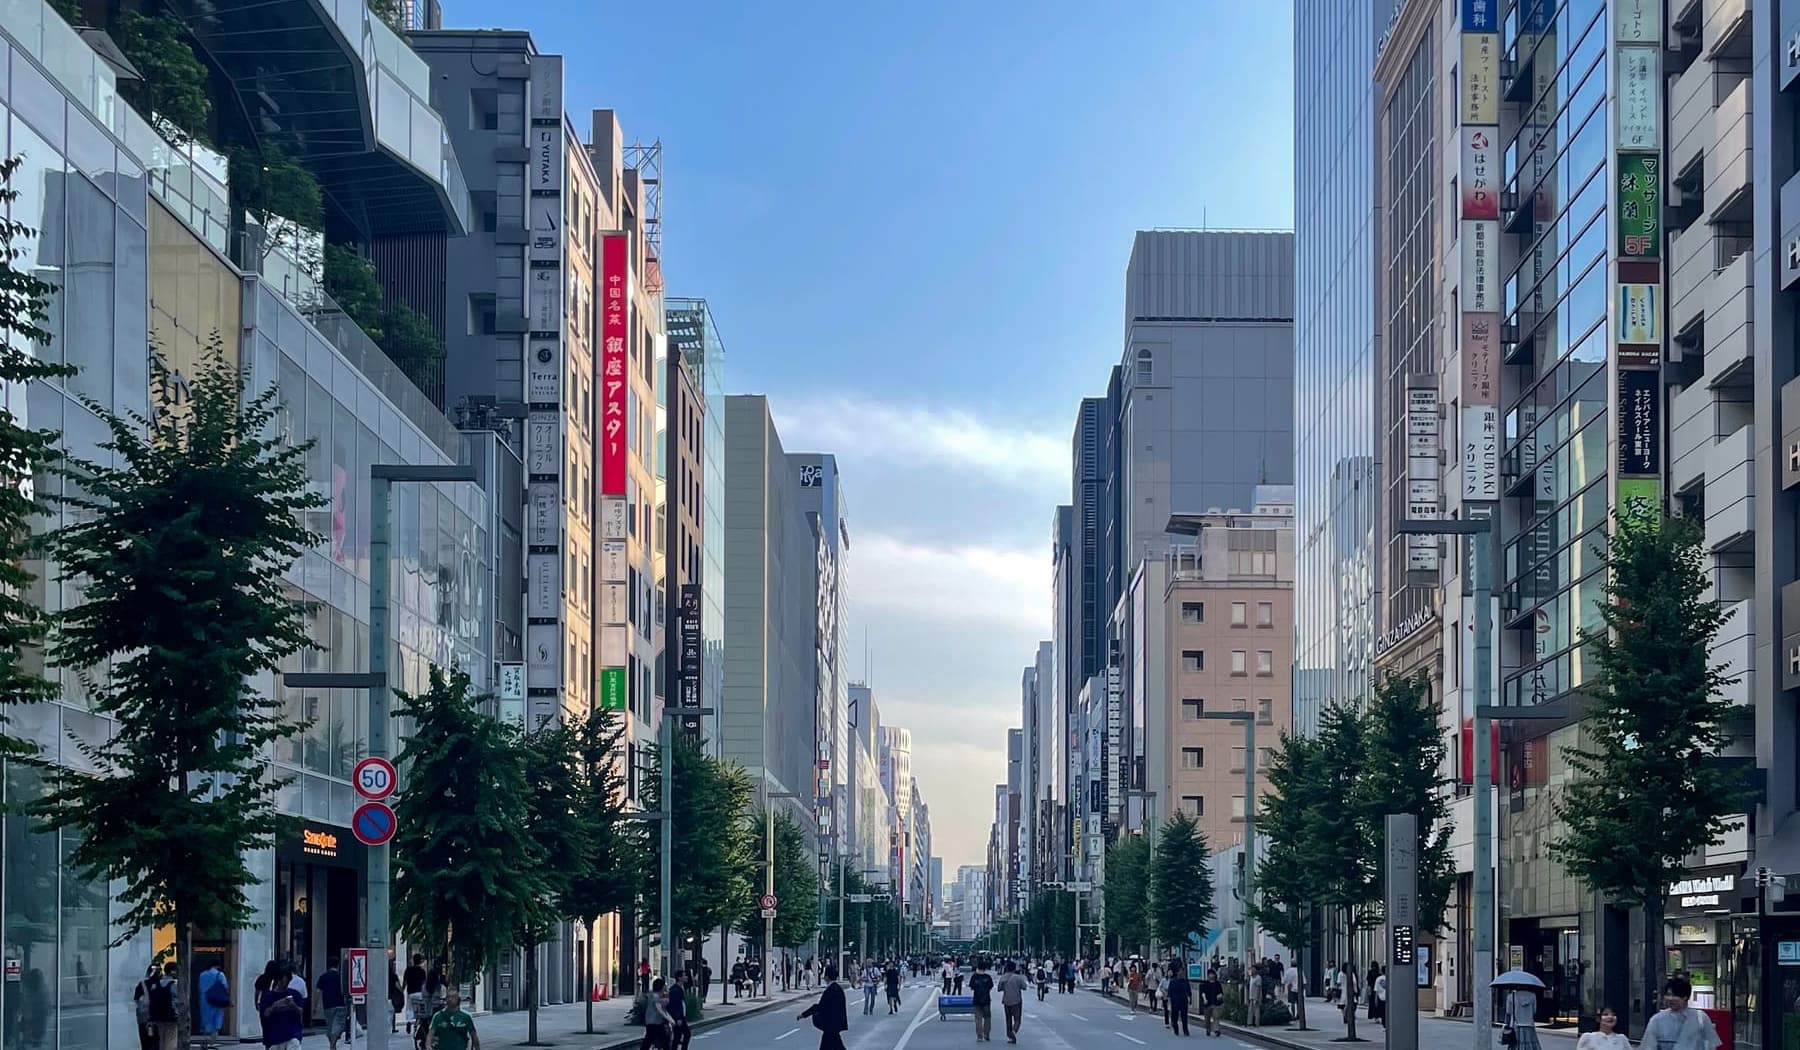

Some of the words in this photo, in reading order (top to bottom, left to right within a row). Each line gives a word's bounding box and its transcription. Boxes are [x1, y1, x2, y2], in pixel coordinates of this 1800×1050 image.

[1481, 36, 1489, 103] 銀座ファースト
[1632, 135, 1644, 144] 6F
[541, 145, 552, 184] YUTAKA
[1474, 154, 1486, 200] はせがわ
[1642, 159, 1657, 234] マッサージ
[1625, 235, 1652, 254] 5F
[609, 274, 621, 326] 中国名菜
[531, 372, 558, 381] Terra
[1471, 352, 1479, 391] クリニック
[606, 336, 623, 457] 銀座アスター
[544, 425, 552, 463] オーラル
[1467, 443, 1476, 494] クリニック
[362, 770, 387, 788] 50
